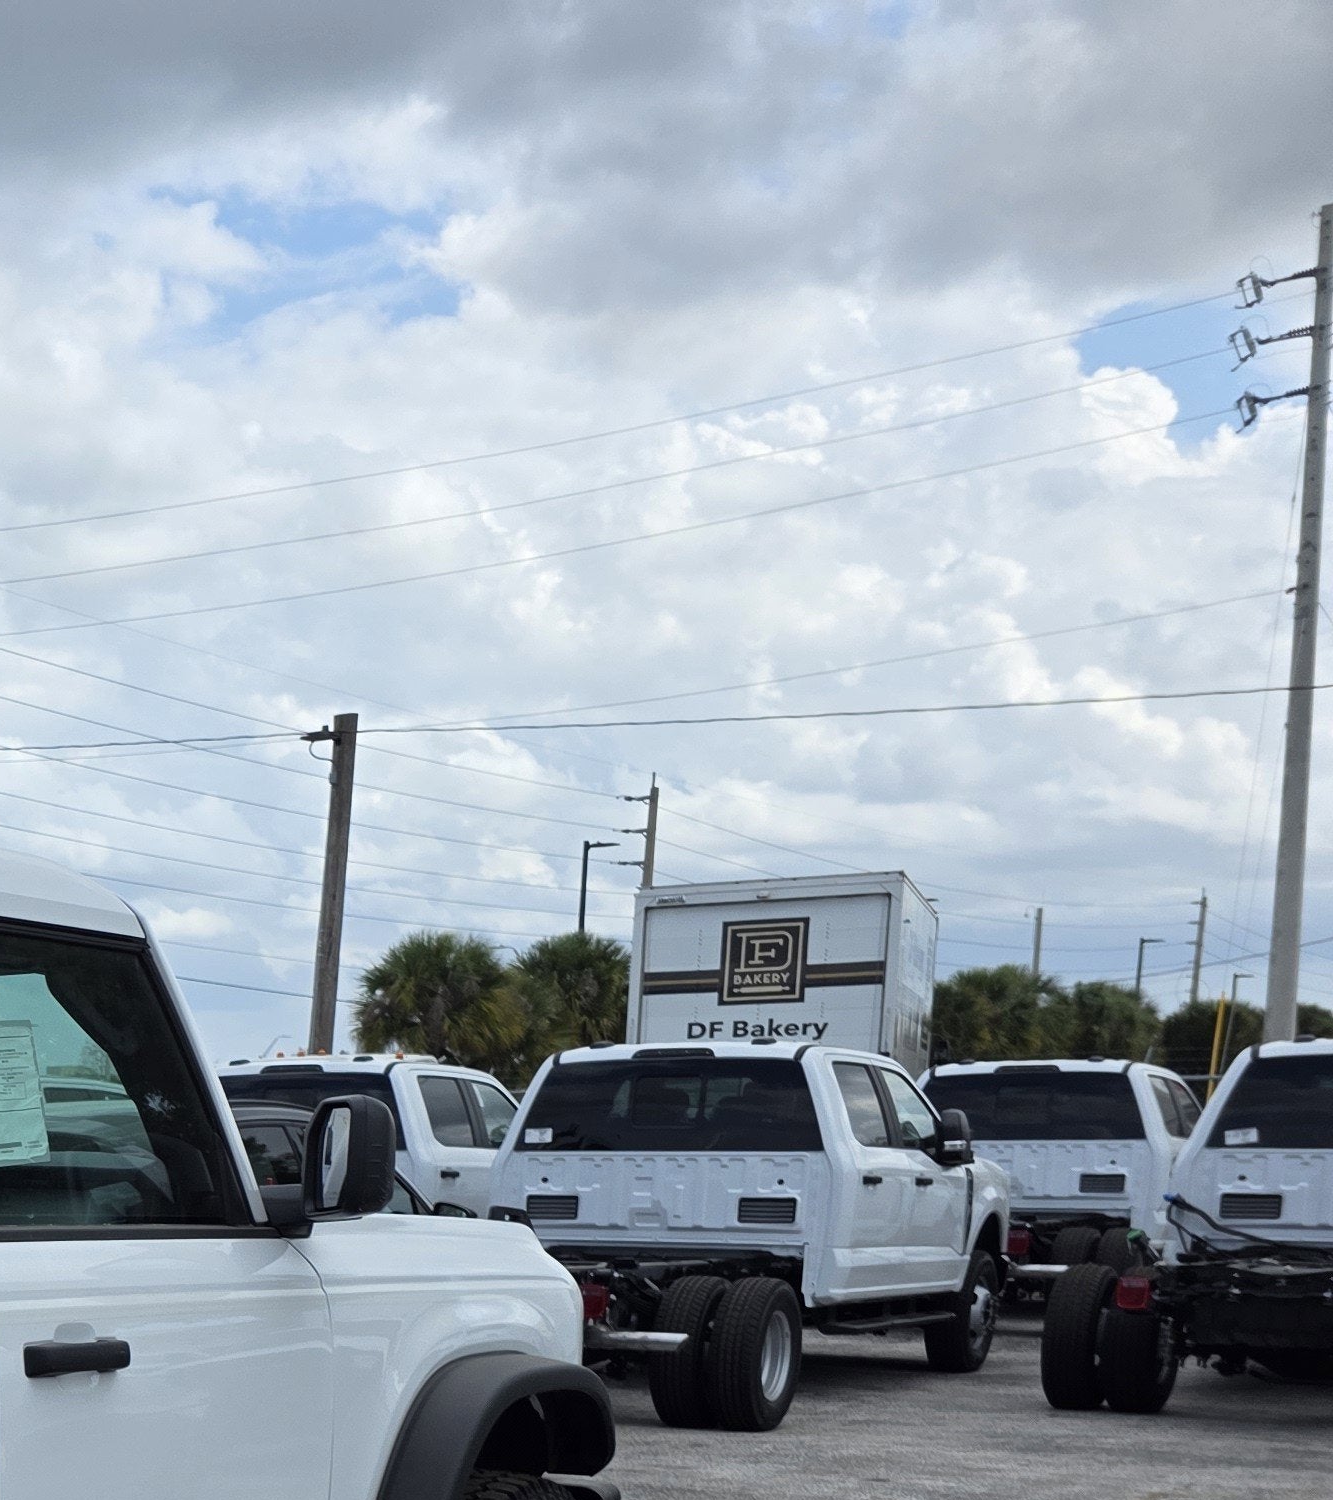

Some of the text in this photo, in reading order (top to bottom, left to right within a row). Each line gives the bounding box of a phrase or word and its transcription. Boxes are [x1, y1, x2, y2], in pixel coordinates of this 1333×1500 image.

[732, 971, 791, 986] BAKERY
[686, 1017, 829, 1041] DF Bakery
